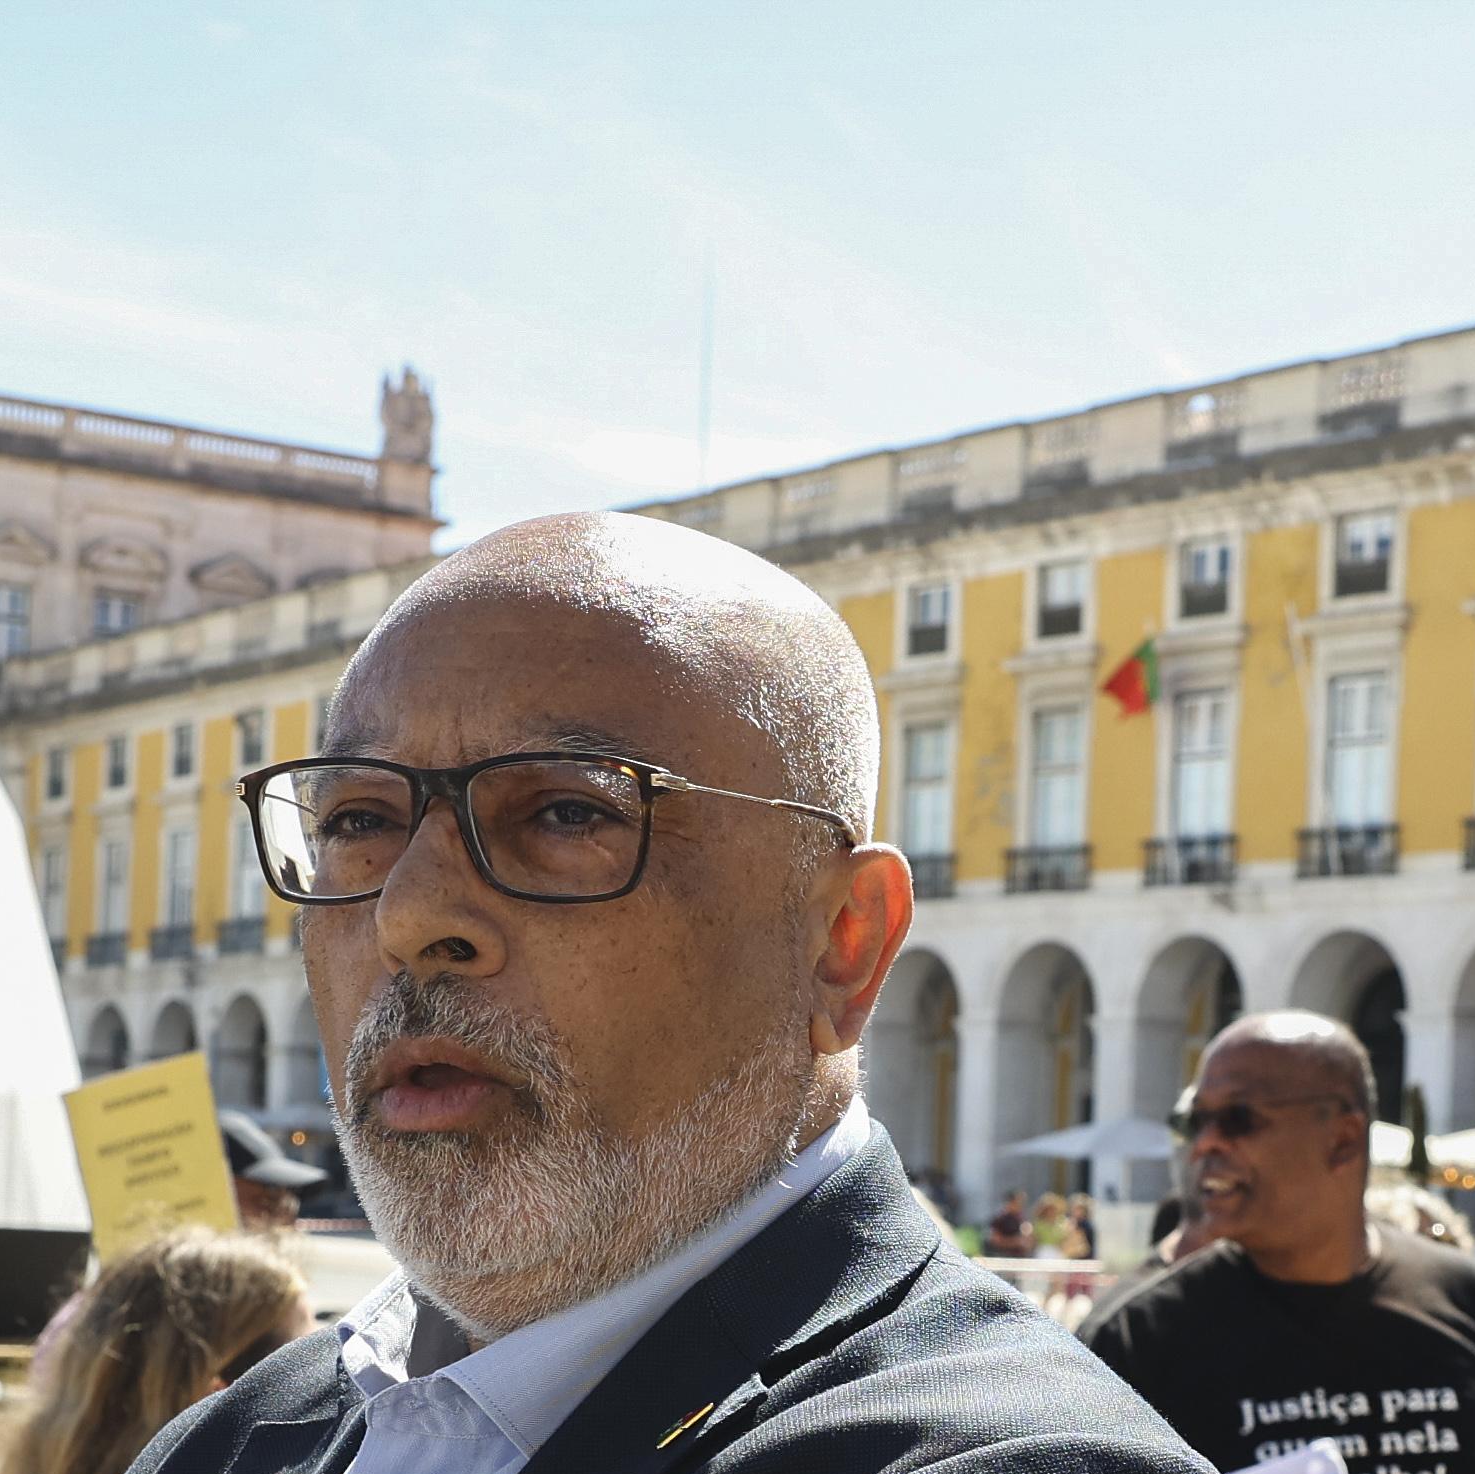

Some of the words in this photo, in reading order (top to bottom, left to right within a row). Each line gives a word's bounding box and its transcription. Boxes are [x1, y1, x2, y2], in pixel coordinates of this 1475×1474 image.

[1239, 1387, 1371, 1437] Justiça
[1380, 1386, 1460, 1423] para
[1255, 1433, 1368, 1464] qum
[1380, 1421, 1460, 1456] nela
